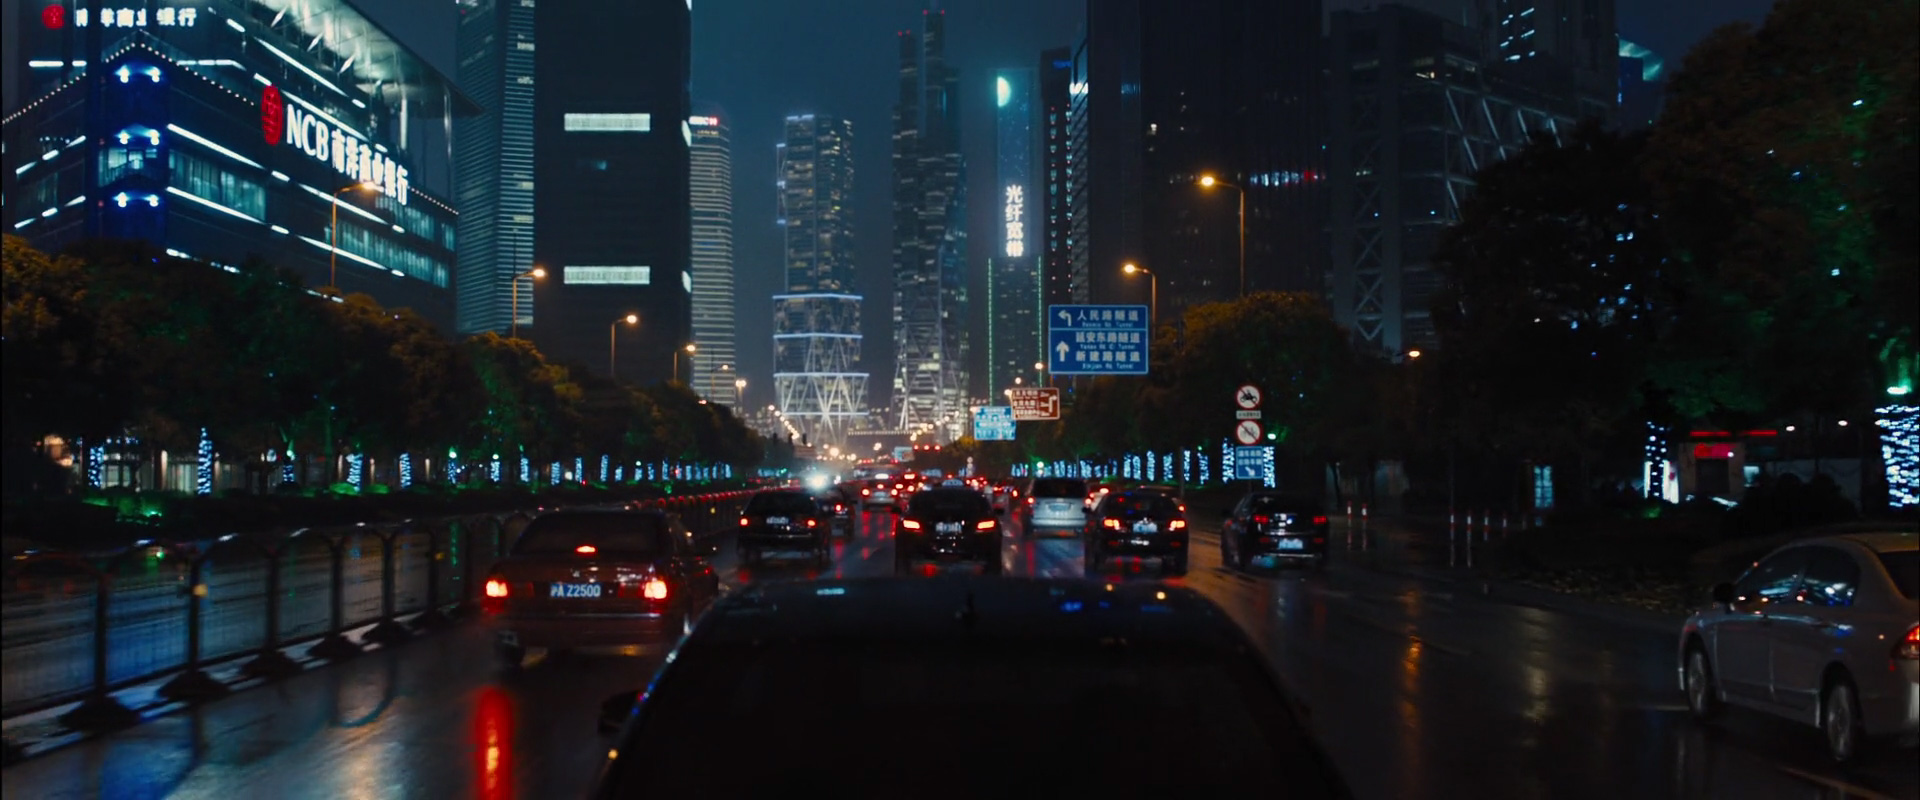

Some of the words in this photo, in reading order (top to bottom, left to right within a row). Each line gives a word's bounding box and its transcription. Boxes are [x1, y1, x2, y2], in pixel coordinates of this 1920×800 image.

[286, 103, 329, 162] NCB
[1005, 184, 1024, 257] 光纤宽带
[1077, 309, 1139, 321] 人民路隧道
[1076, 331, 1140, 343] 延安东路隧道
[1076, 351, 1140, 362] 新建路隧道
[566, 583, 601, 598] Z2500
